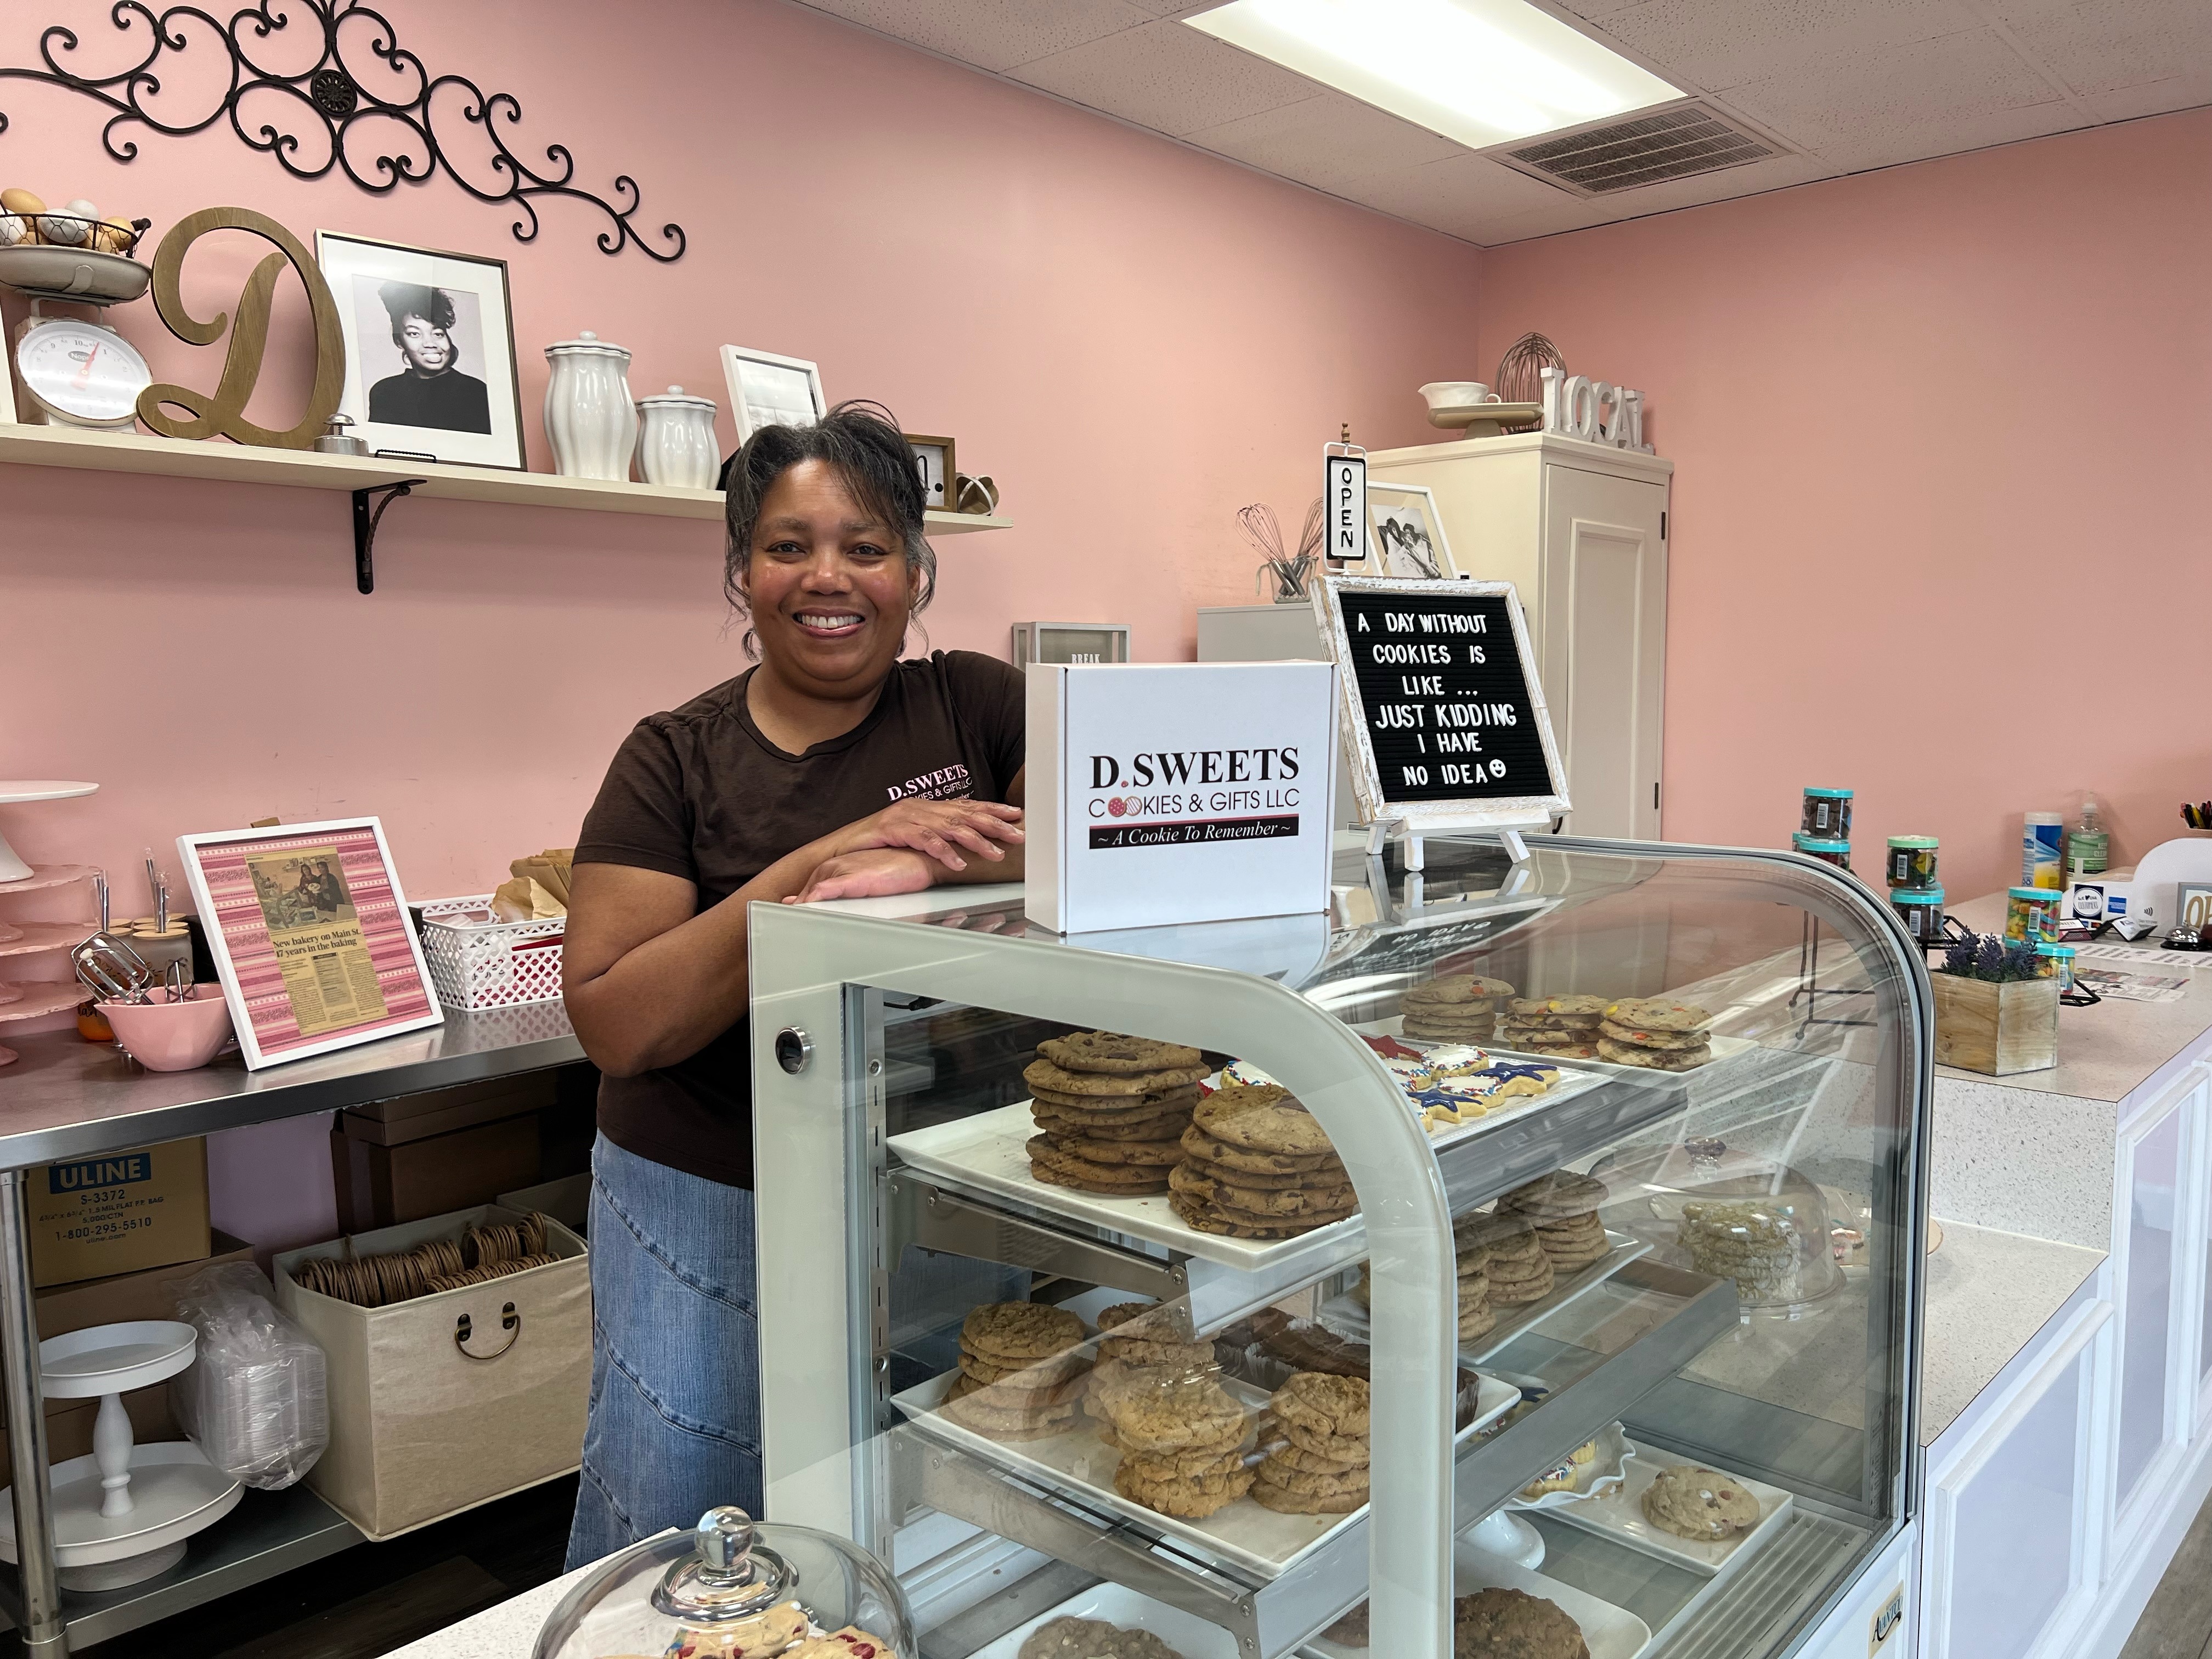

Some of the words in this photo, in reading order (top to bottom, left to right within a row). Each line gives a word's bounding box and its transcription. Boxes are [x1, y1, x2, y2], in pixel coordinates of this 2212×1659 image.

[1541, 366, 1656, 455] LOCAL
[1341, 467, 1353, 549] OPEN
[1358, 613, 1370, 632] A
[1385, 613, 1414, 632] DAY
[1419, 614, 1487, 634] WITHOUT
[1071, 653, 1100, 663] BREAK
[1373, 644, 1451, 664] COOKIES
[1469, 645, 1486, 664] IS
[1402, 676, 1445, 695] LIKE
[1375, 704, 1424, 729] JUST
[1435, 704, 1516, 728] KIDDING
[1417, 733, 1425, 753] I
[1436, 732, 1482, 753] HAVE
[1403, 766, 1428, 786] NO
[1441, 764, 1488, 785] IDEA
[943, 780, 962, 794] GIFTS
[1189, 793, 1203, 812] &
[1210, 791, 1260, 811] GIFTS
[1267, 788, 1300, 808] LLC
[1112, 830, 1124, 845] A
[1128, 826, 1180, 844] Cookie
[1185, 825, 1200, 840] To
[1205, 821, 1278, 839] Remember
[273, 940, 291, 949] New
[291, 935, 319, 945] bakery
[331, 930, 351, 939] Main
[285, 947, 307, 958] years
[330, 939, 357, 948] baking
[60, 1159, 141, 1188] ULINE
[81, 1189, 125, 1205] S-3372
[55, 1217, 152, 1241] 1-800-295-5510
